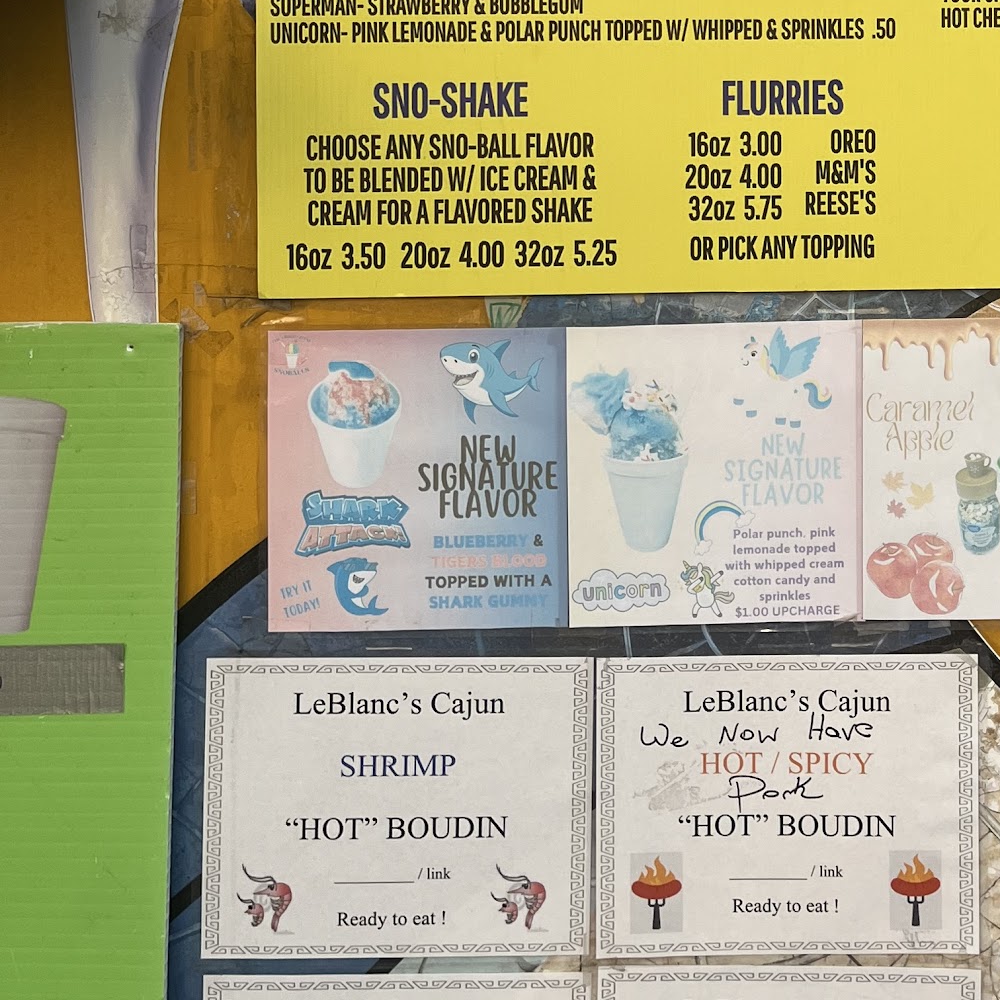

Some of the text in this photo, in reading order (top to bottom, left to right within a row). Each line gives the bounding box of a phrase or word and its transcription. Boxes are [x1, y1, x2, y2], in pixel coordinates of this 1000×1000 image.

[372, 82, 529, 119] SNO-SHAKE
[722, 79, 844, 116] FLURRIES
[830, 129, 876, 153] OREO
[815, 160, 876, 184] M&M'S
[286, 239, 618, 270] 16oz 3.50 20oz 4.00 32oz 5.25
[866, 391, 974, 422] Caramel
[461, 435, 515, 465] NEW
[886, 423, 954, 460] Apple
[418, 461, 558, 491] SIGNATURE
[304, 491, 404, 521] SHARK
[440, 489, 537, 519] FLAVOR
[433, 534, 543, 548] BLUEBERRY &
[733, 529, 763, 539] Polar
[810, 527, 835, 539] pink
[725, 559, 844, 573] with whipped cream
[280, 583, 299, 599] TRY
[425, 574, 552, 588] TOPPED WITH A
[582, 581, 663, 601] unicorn
[283, 598, 320, 618] TODAY!
[760, 590, 810, 603] sprinkles
[735, 605, 840, 618] $1.00 UPCHARGE
[294, 692, 505, 720] LeBlanc’s Cajun
[640, 724, 688, 748] We
[809, 712, 874, 740] Have
[340, 754, 456, 778] SHRIMP
[700, 752, 874, 775] HOT / SPICY
[728, 776, 824, 813] Pork
[386, 816, 508, 839] BOUDIN
